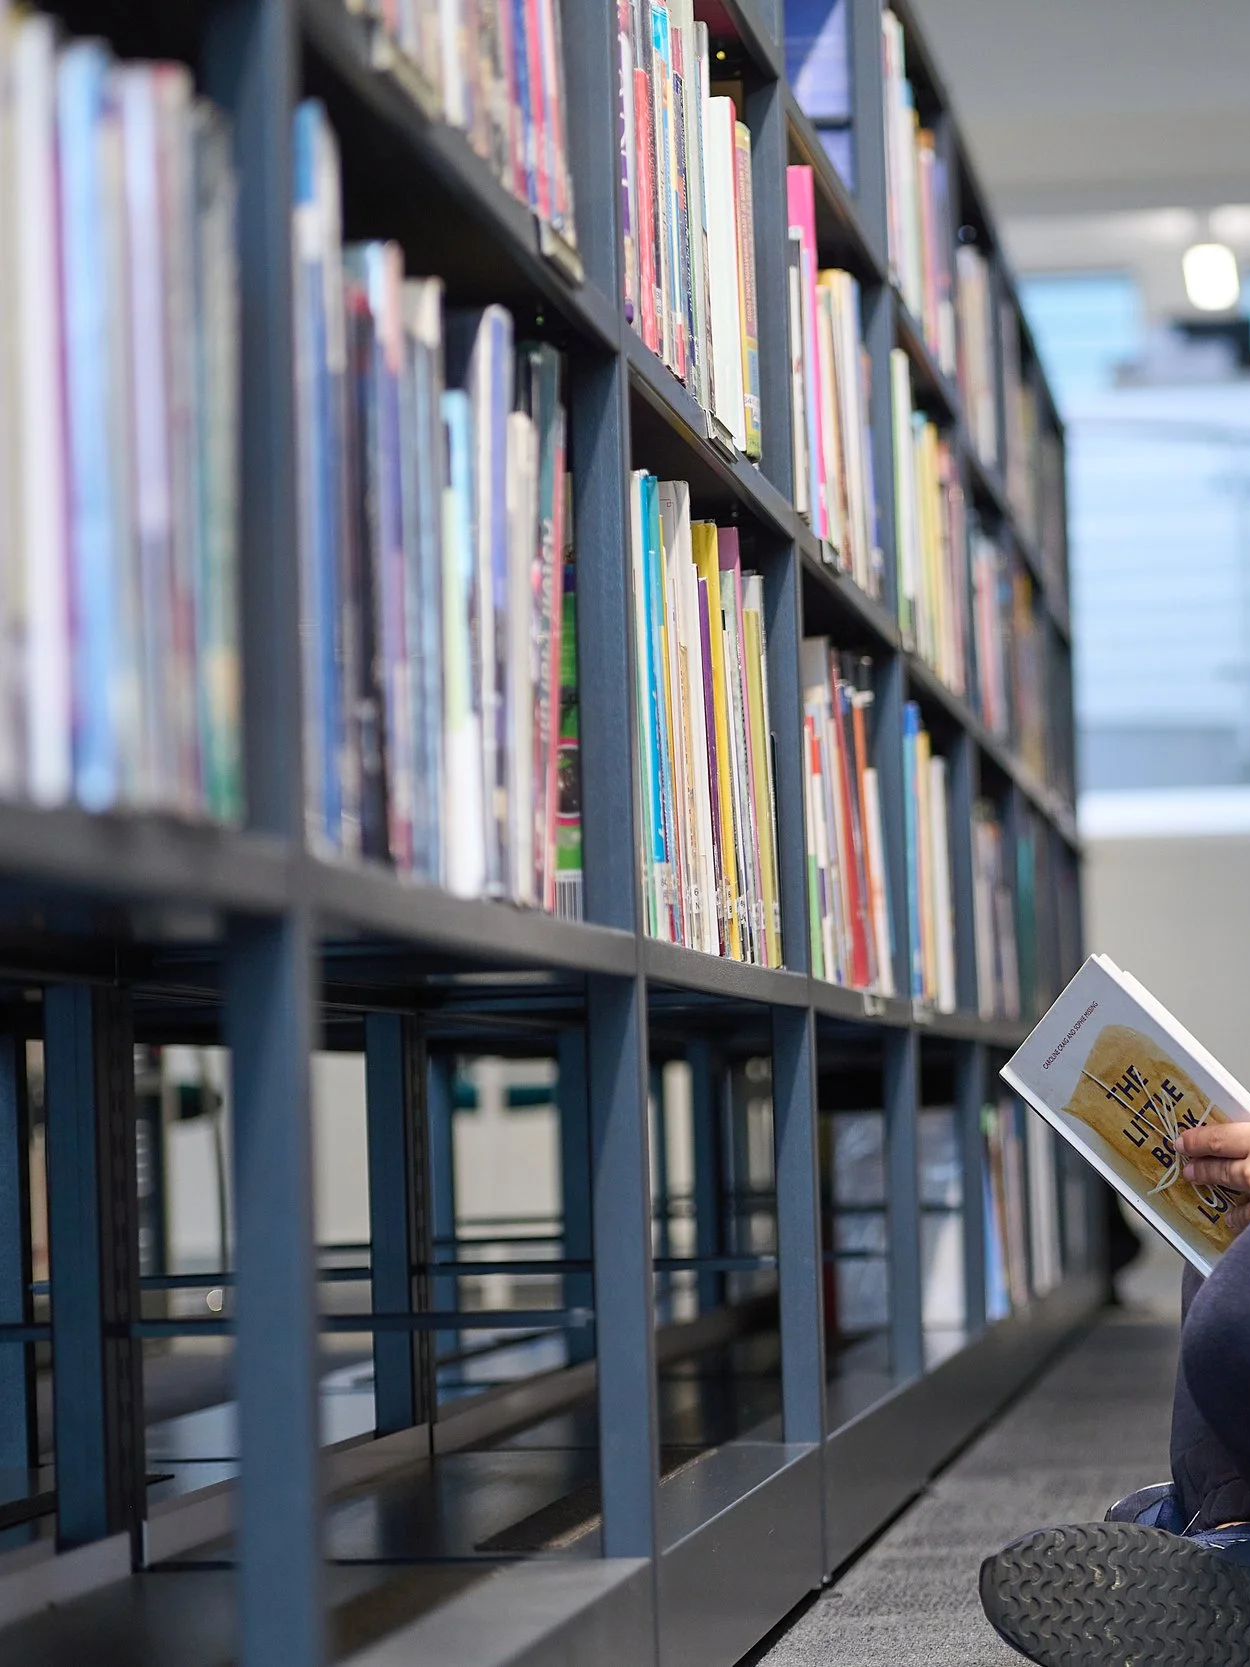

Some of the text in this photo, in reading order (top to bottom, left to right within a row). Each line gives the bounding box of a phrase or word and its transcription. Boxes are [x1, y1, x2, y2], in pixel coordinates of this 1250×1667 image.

[1042, 1049, 1060, 1070] CAROLINE
[1057, 1037, 1070, 1052] CRAIG
[1066, 1028, 1077, 1040] AND
[1073, 1015, 1087, 1031] SOPHIE
[1105, 1065, 1149, 1109] THE
[1122, 1079, 1184, 1148] LITTLE
